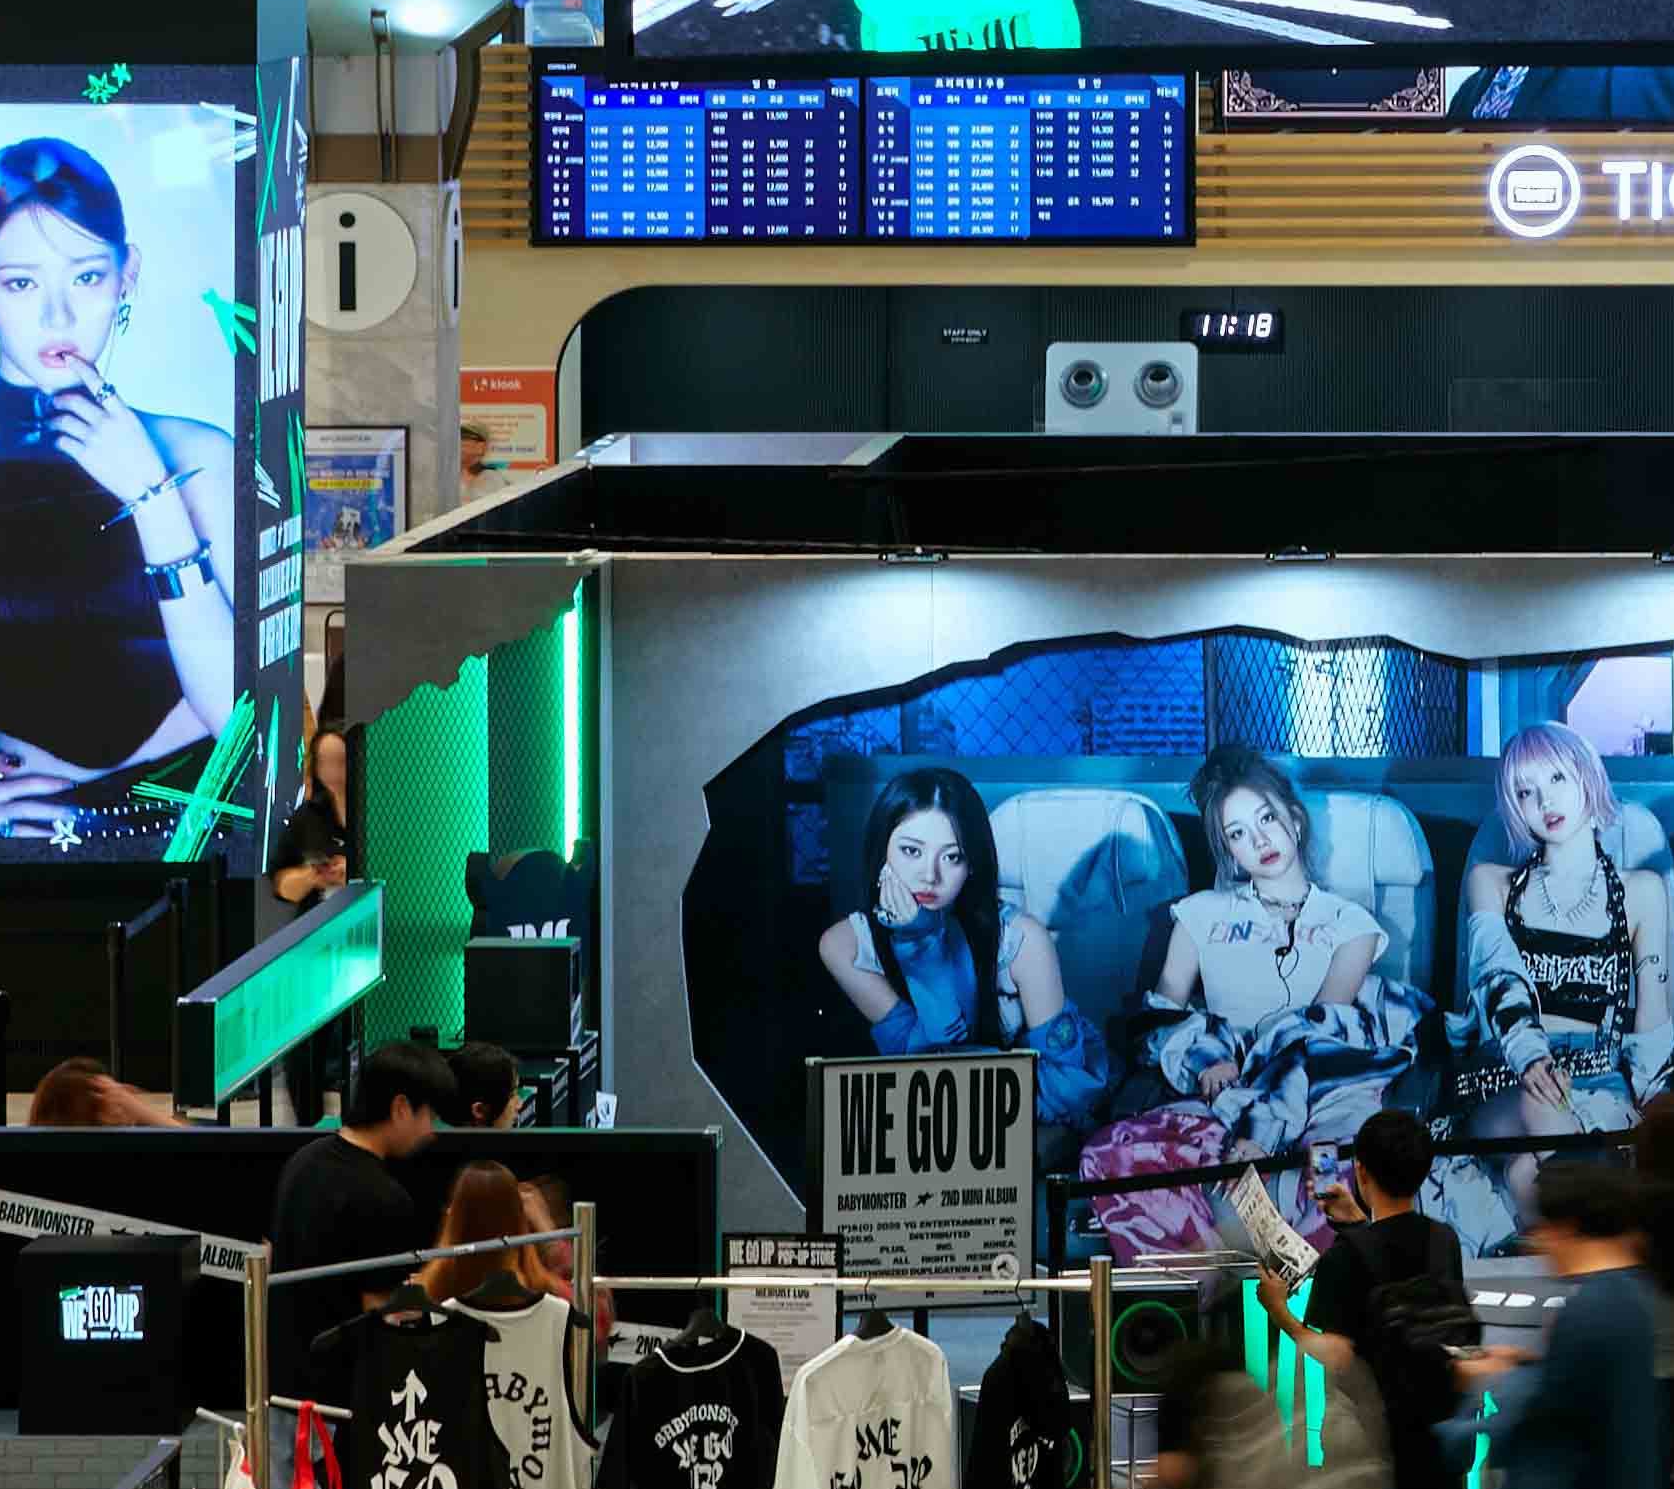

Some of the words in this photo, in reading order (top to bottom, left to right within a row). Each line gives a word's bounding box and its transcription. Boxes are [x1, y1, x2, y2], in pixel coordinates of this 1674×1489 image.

[1201, 312, 1273, 338] 11:18
[839, 1072, 897, 1177] WE
[907, 1069, 958, 1174] GO
[969, 1067, 1021, 1171] UP
[837, 1192, 907, 1212] BABYMONSTER
[941, 1188, 960, 1208] 2ND
[961, 1187, 982, 1207] MINI
[985, 1186, 1018, 1206] ALBUM
[729, 1240, 744, 1265] WE
[746, 1240, 759, 1265] GO
[761, 1240, 775, 1265] UP
[778, 1249, 810, 1266] POP-UP
[811, 1249, 837, 1266] STORE
[62, 1298, 87, 1340] WE
[92, 1289, 111, 1324] GO
[116, 1292, 141, 1333] UP
